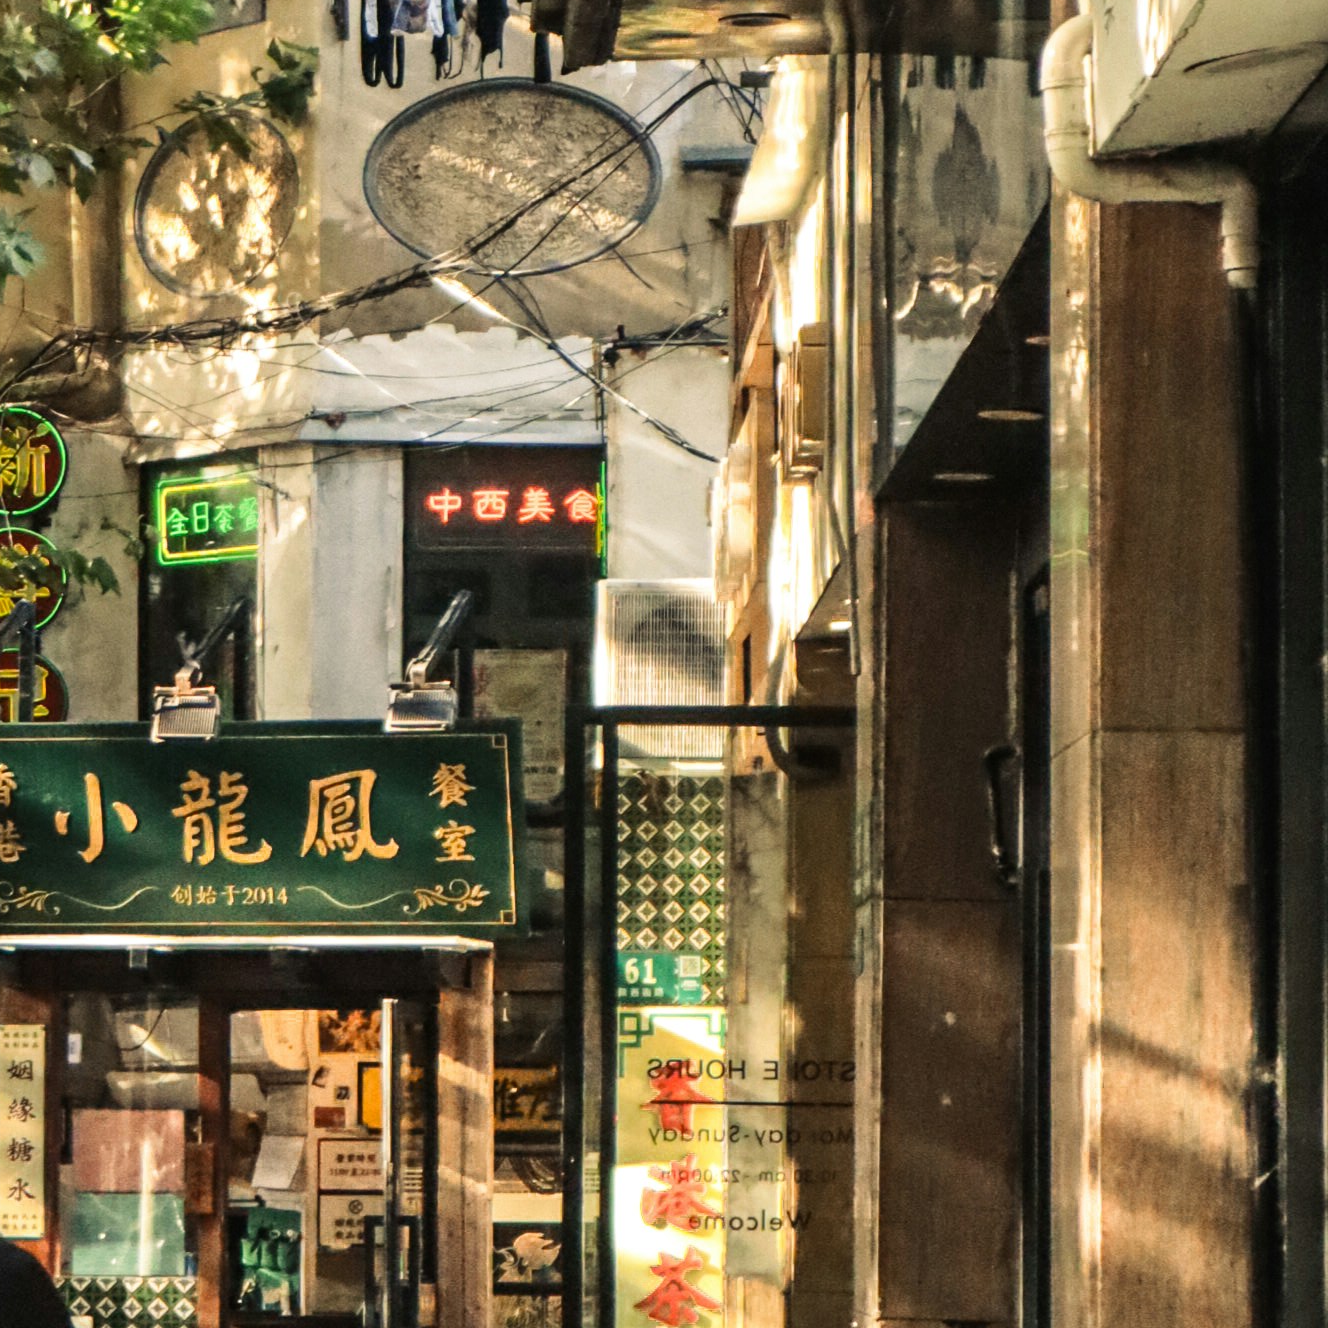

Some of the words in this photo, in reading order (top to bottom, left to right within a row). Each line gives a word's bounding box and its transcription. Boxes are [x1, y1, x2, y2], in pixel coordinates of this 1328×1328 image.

[425, 485, 600, 524] 中西美食
[54, 768, 400, 866] 小龍鳳
[428, 762, 477, 864] 餐室
[170, 883, 289, 906] 创始于2014
[625, 957, 657, 985] 61
[7, 1059, 37, 1203] 姻緣糖水
